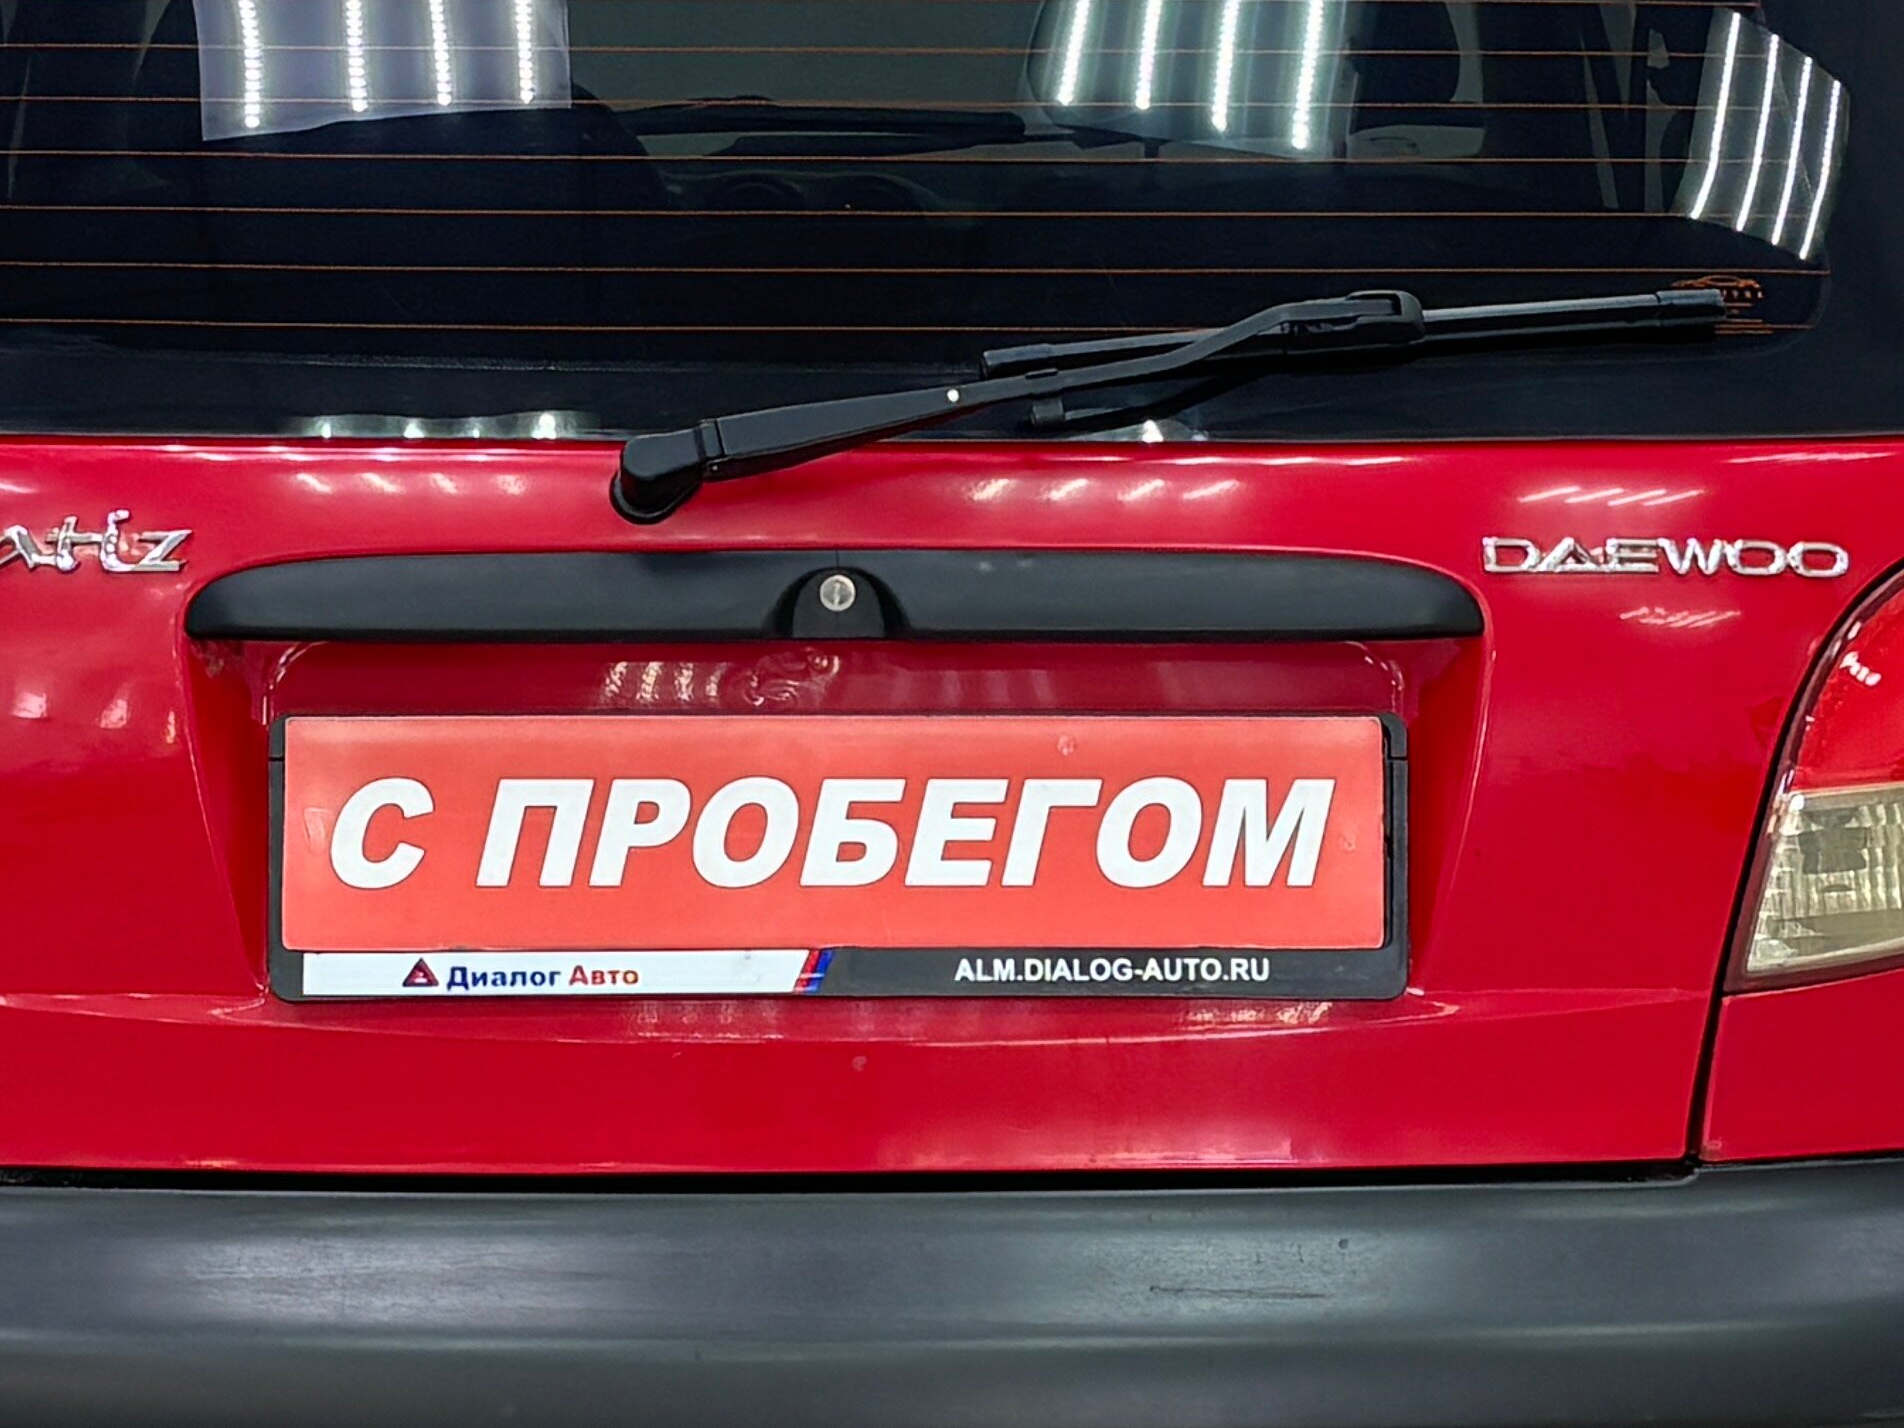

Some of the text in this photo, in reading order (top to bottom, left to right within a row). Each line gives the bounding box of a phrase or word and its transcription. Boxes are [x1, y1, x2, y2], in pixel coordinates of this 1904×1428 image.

[1482, 536, 1849, 578] DAEWOO
[329, 776, 1336, 890] С ПРОБЕГОМ
[447, 965, 639, 991] Диалог Авто
[954, 958, 1271, 982] ALM.DIALOG-AUTO.RU
